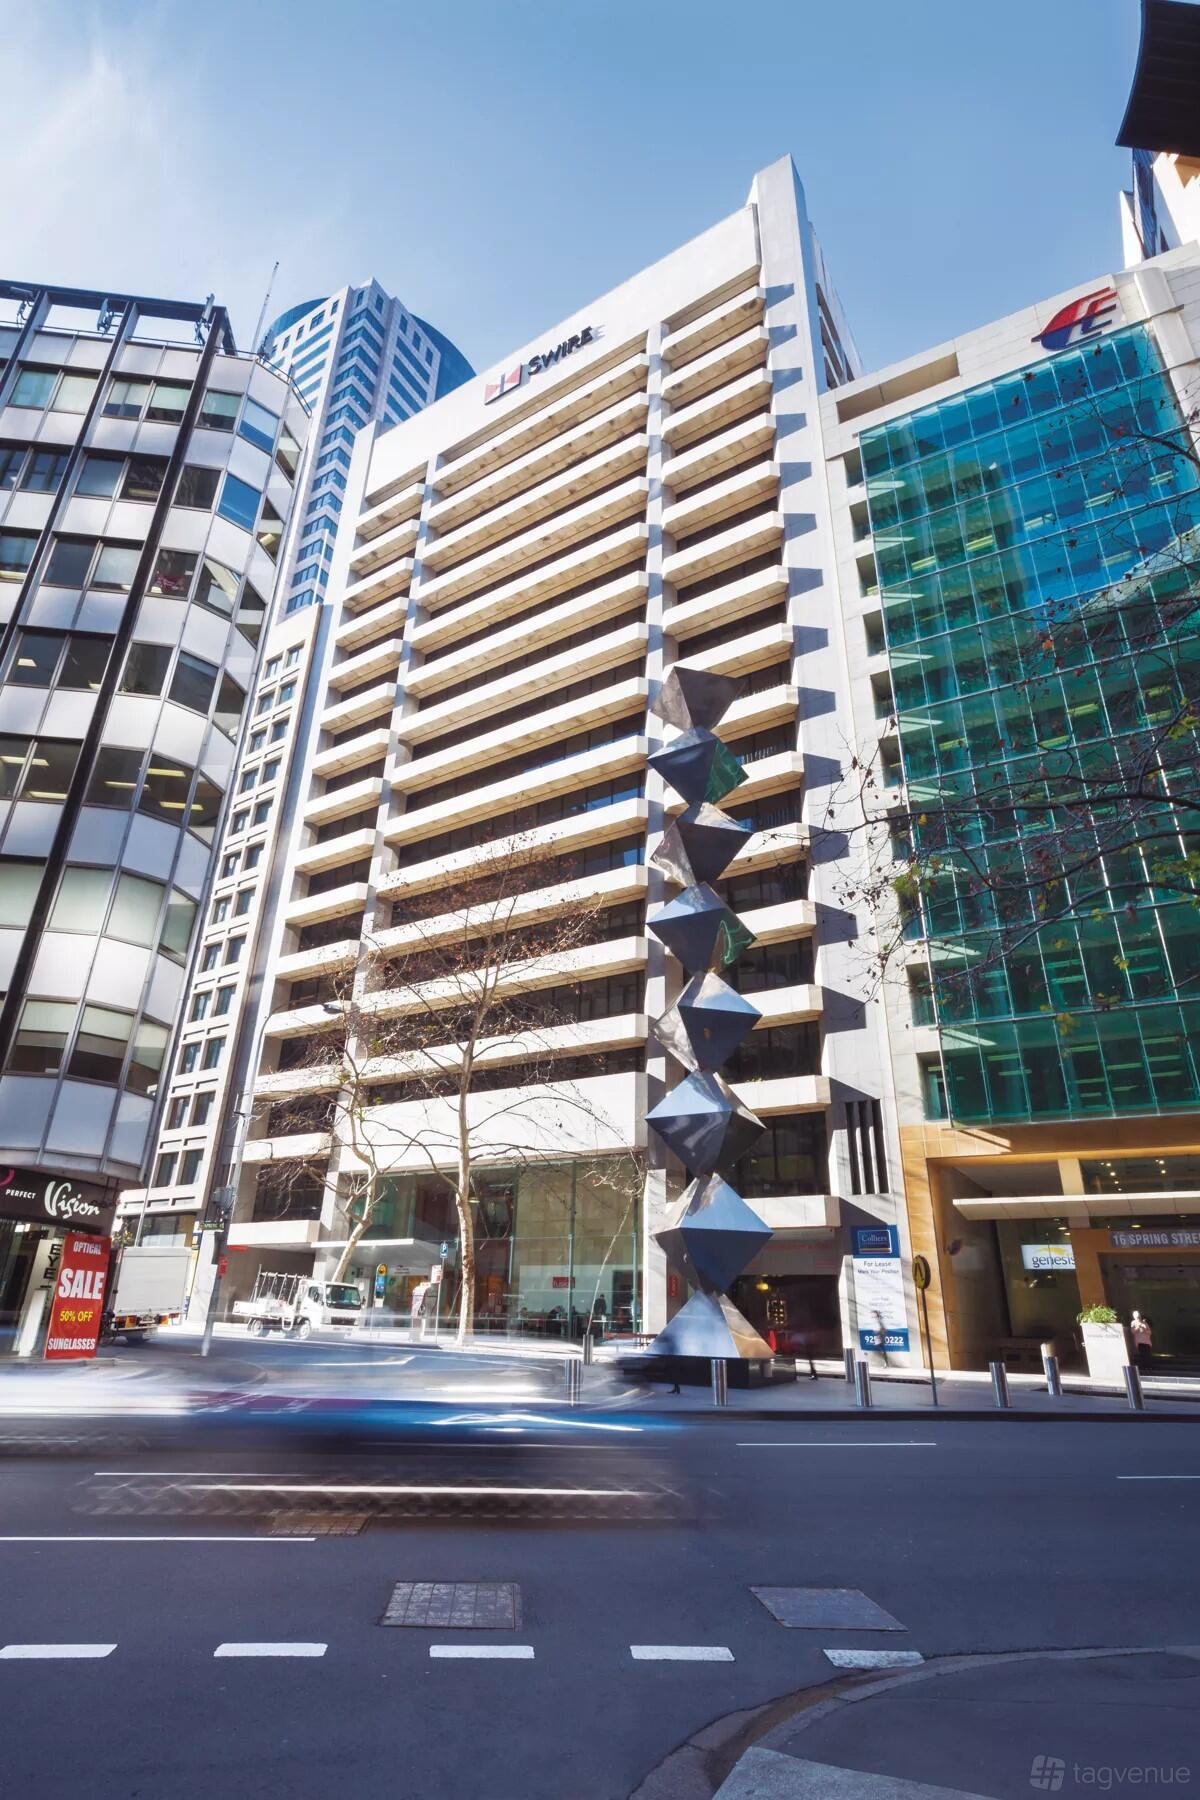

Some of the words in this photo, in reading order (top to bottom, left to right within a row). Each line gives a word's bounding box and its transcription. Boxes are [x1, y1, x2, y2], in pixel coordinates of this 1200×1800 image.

[527, 325, 593, 376] SWIRE
[5, 1188, 37, 1200] PERFECT
[44, 1180, 101, 1219] Vision
[1112, 1234, 1127, 1246] 16
[1128, 1233, 1169, 1245] SPRING
[73, 1240, 102, 1255] OPTICAL
[863, 1260, 873, 1268] For
[874, 1260, 892, 1268] Lease
[1031, 1255, 1075, 1268] genesis
[58, 1267, 105, 1300] SALE
[60, 1310, 75, 1322] 50%
[77, 1310, 93, 1322] OFF
[47, 1337, 96, 1350] SUNGLASSES
[884, 1336, 904, 1344] 0222
